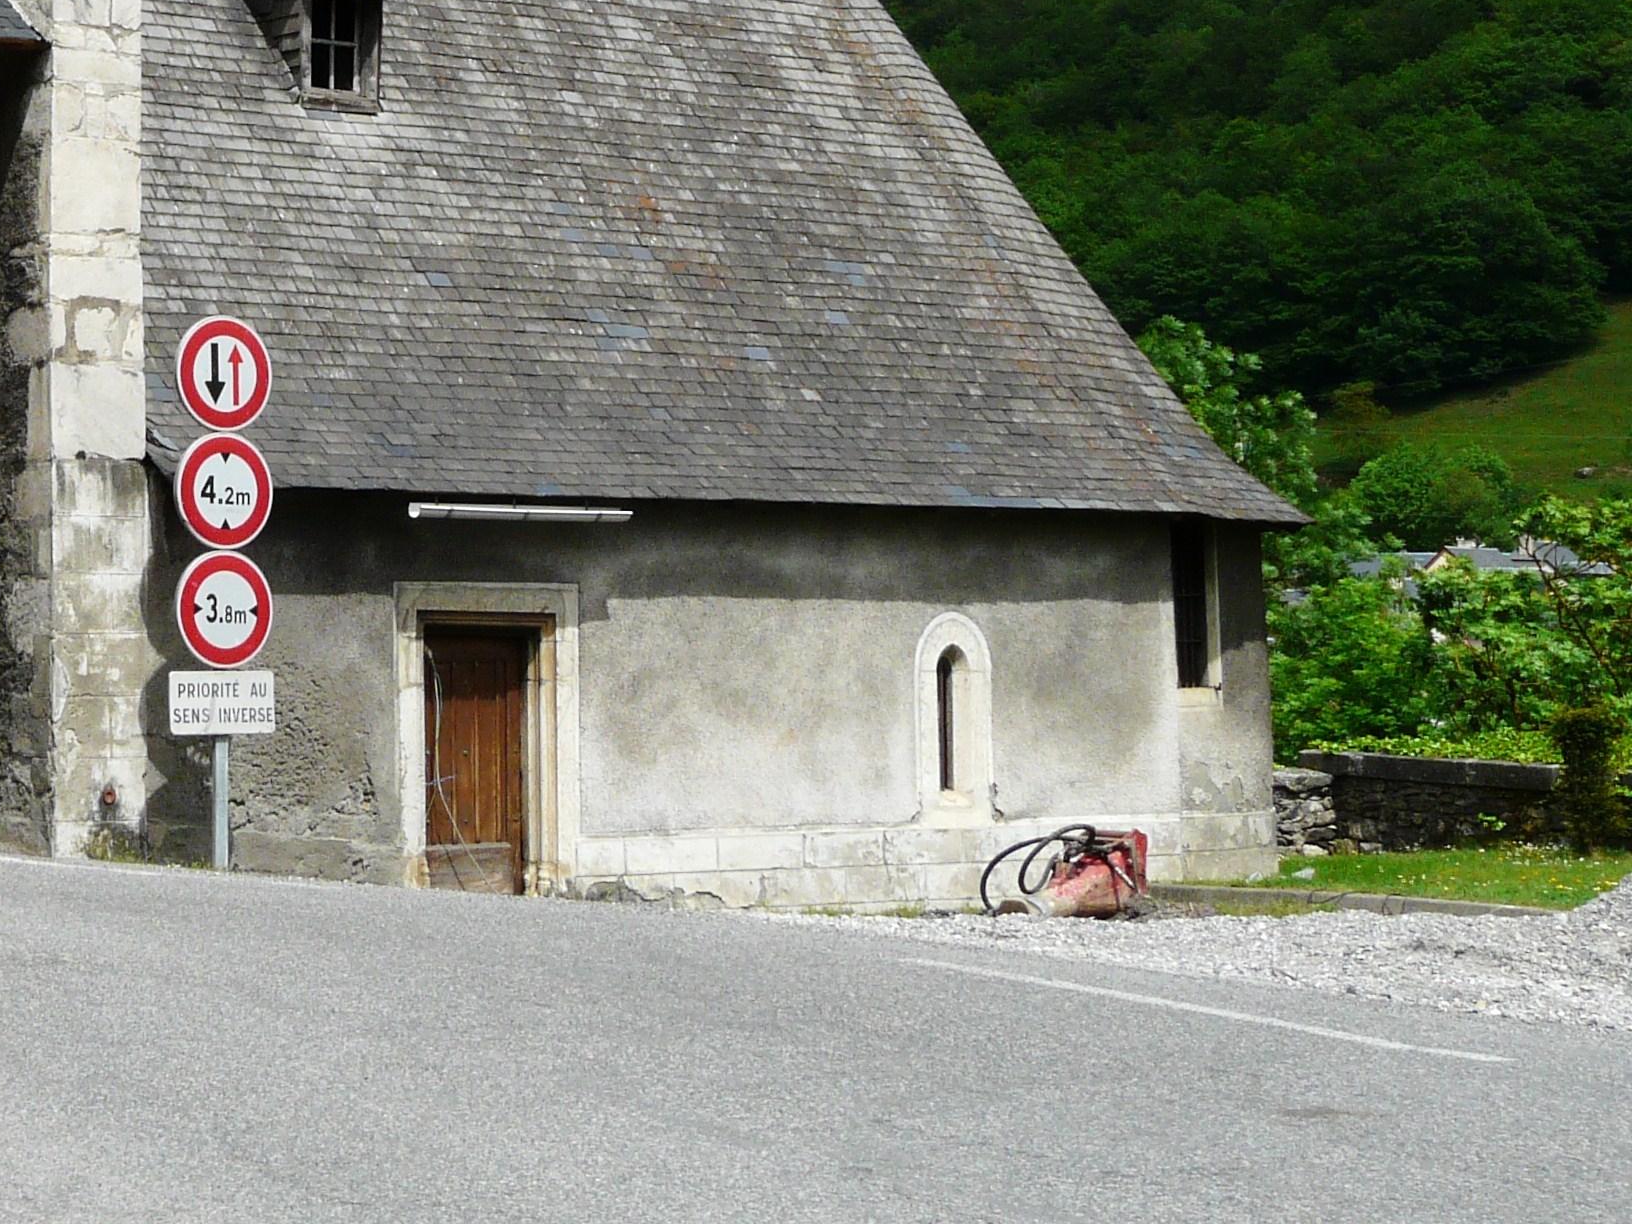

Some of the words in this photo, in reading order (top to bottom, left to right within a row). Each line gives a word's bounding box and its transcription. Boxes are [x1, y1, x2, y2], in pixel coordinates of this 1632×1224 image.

[200, 475, 251, 506] 4.2m
[206, 594, 248, 624] 3.8m
[177, 680, 240, 698] PRIORITÉ
[249, 682, 268, 698] AU
[172, 707, 210, 724] SENS
[218, 707, 274, 724] INVERSE
